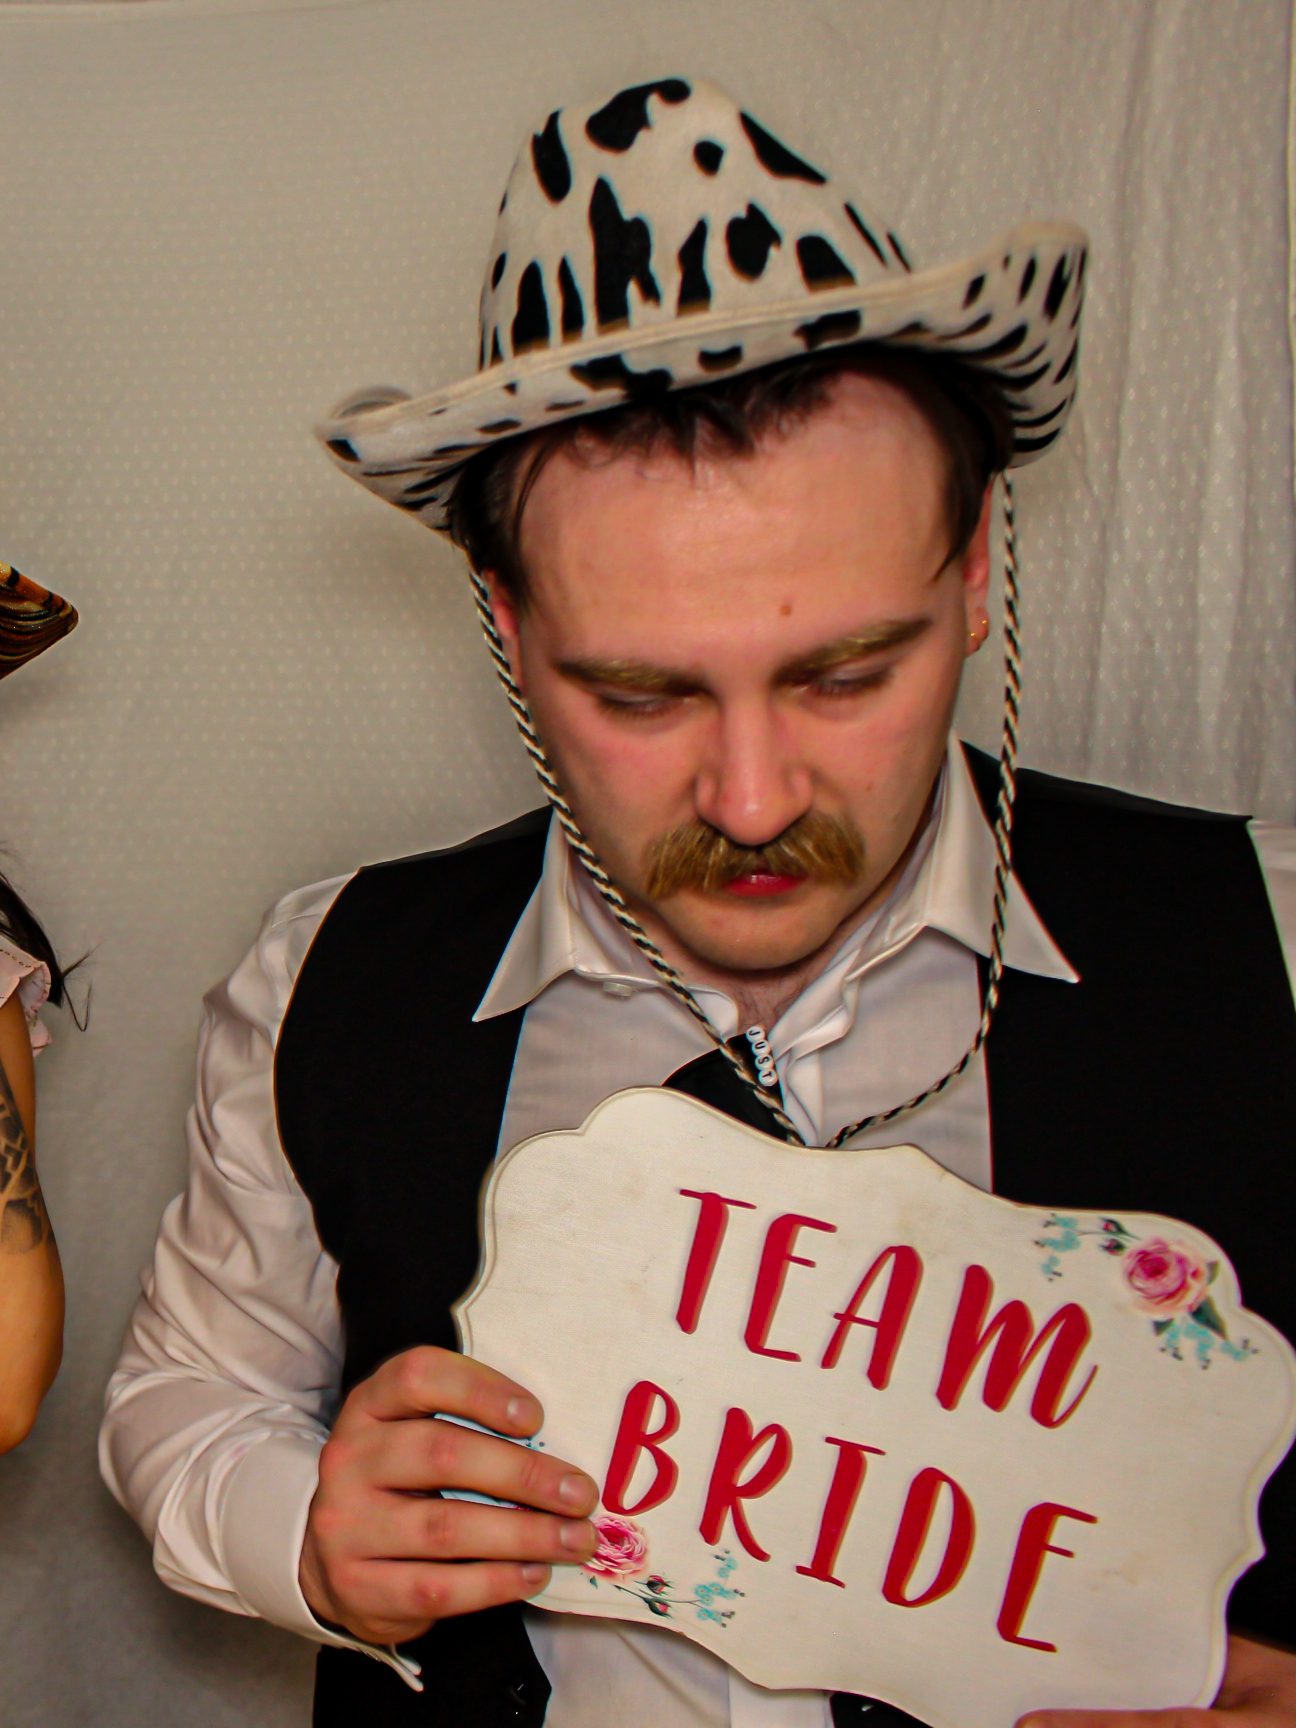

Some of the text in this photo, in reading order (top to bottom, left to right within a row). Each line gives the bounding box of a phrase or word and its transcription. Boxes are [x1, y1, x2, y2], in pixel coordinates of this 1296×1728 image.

[747, 1028, 775, 1080] JUST
[675, 1187, 1099, 1430] TEAM
[601, 1379, 1099, 1654] BRIDE
